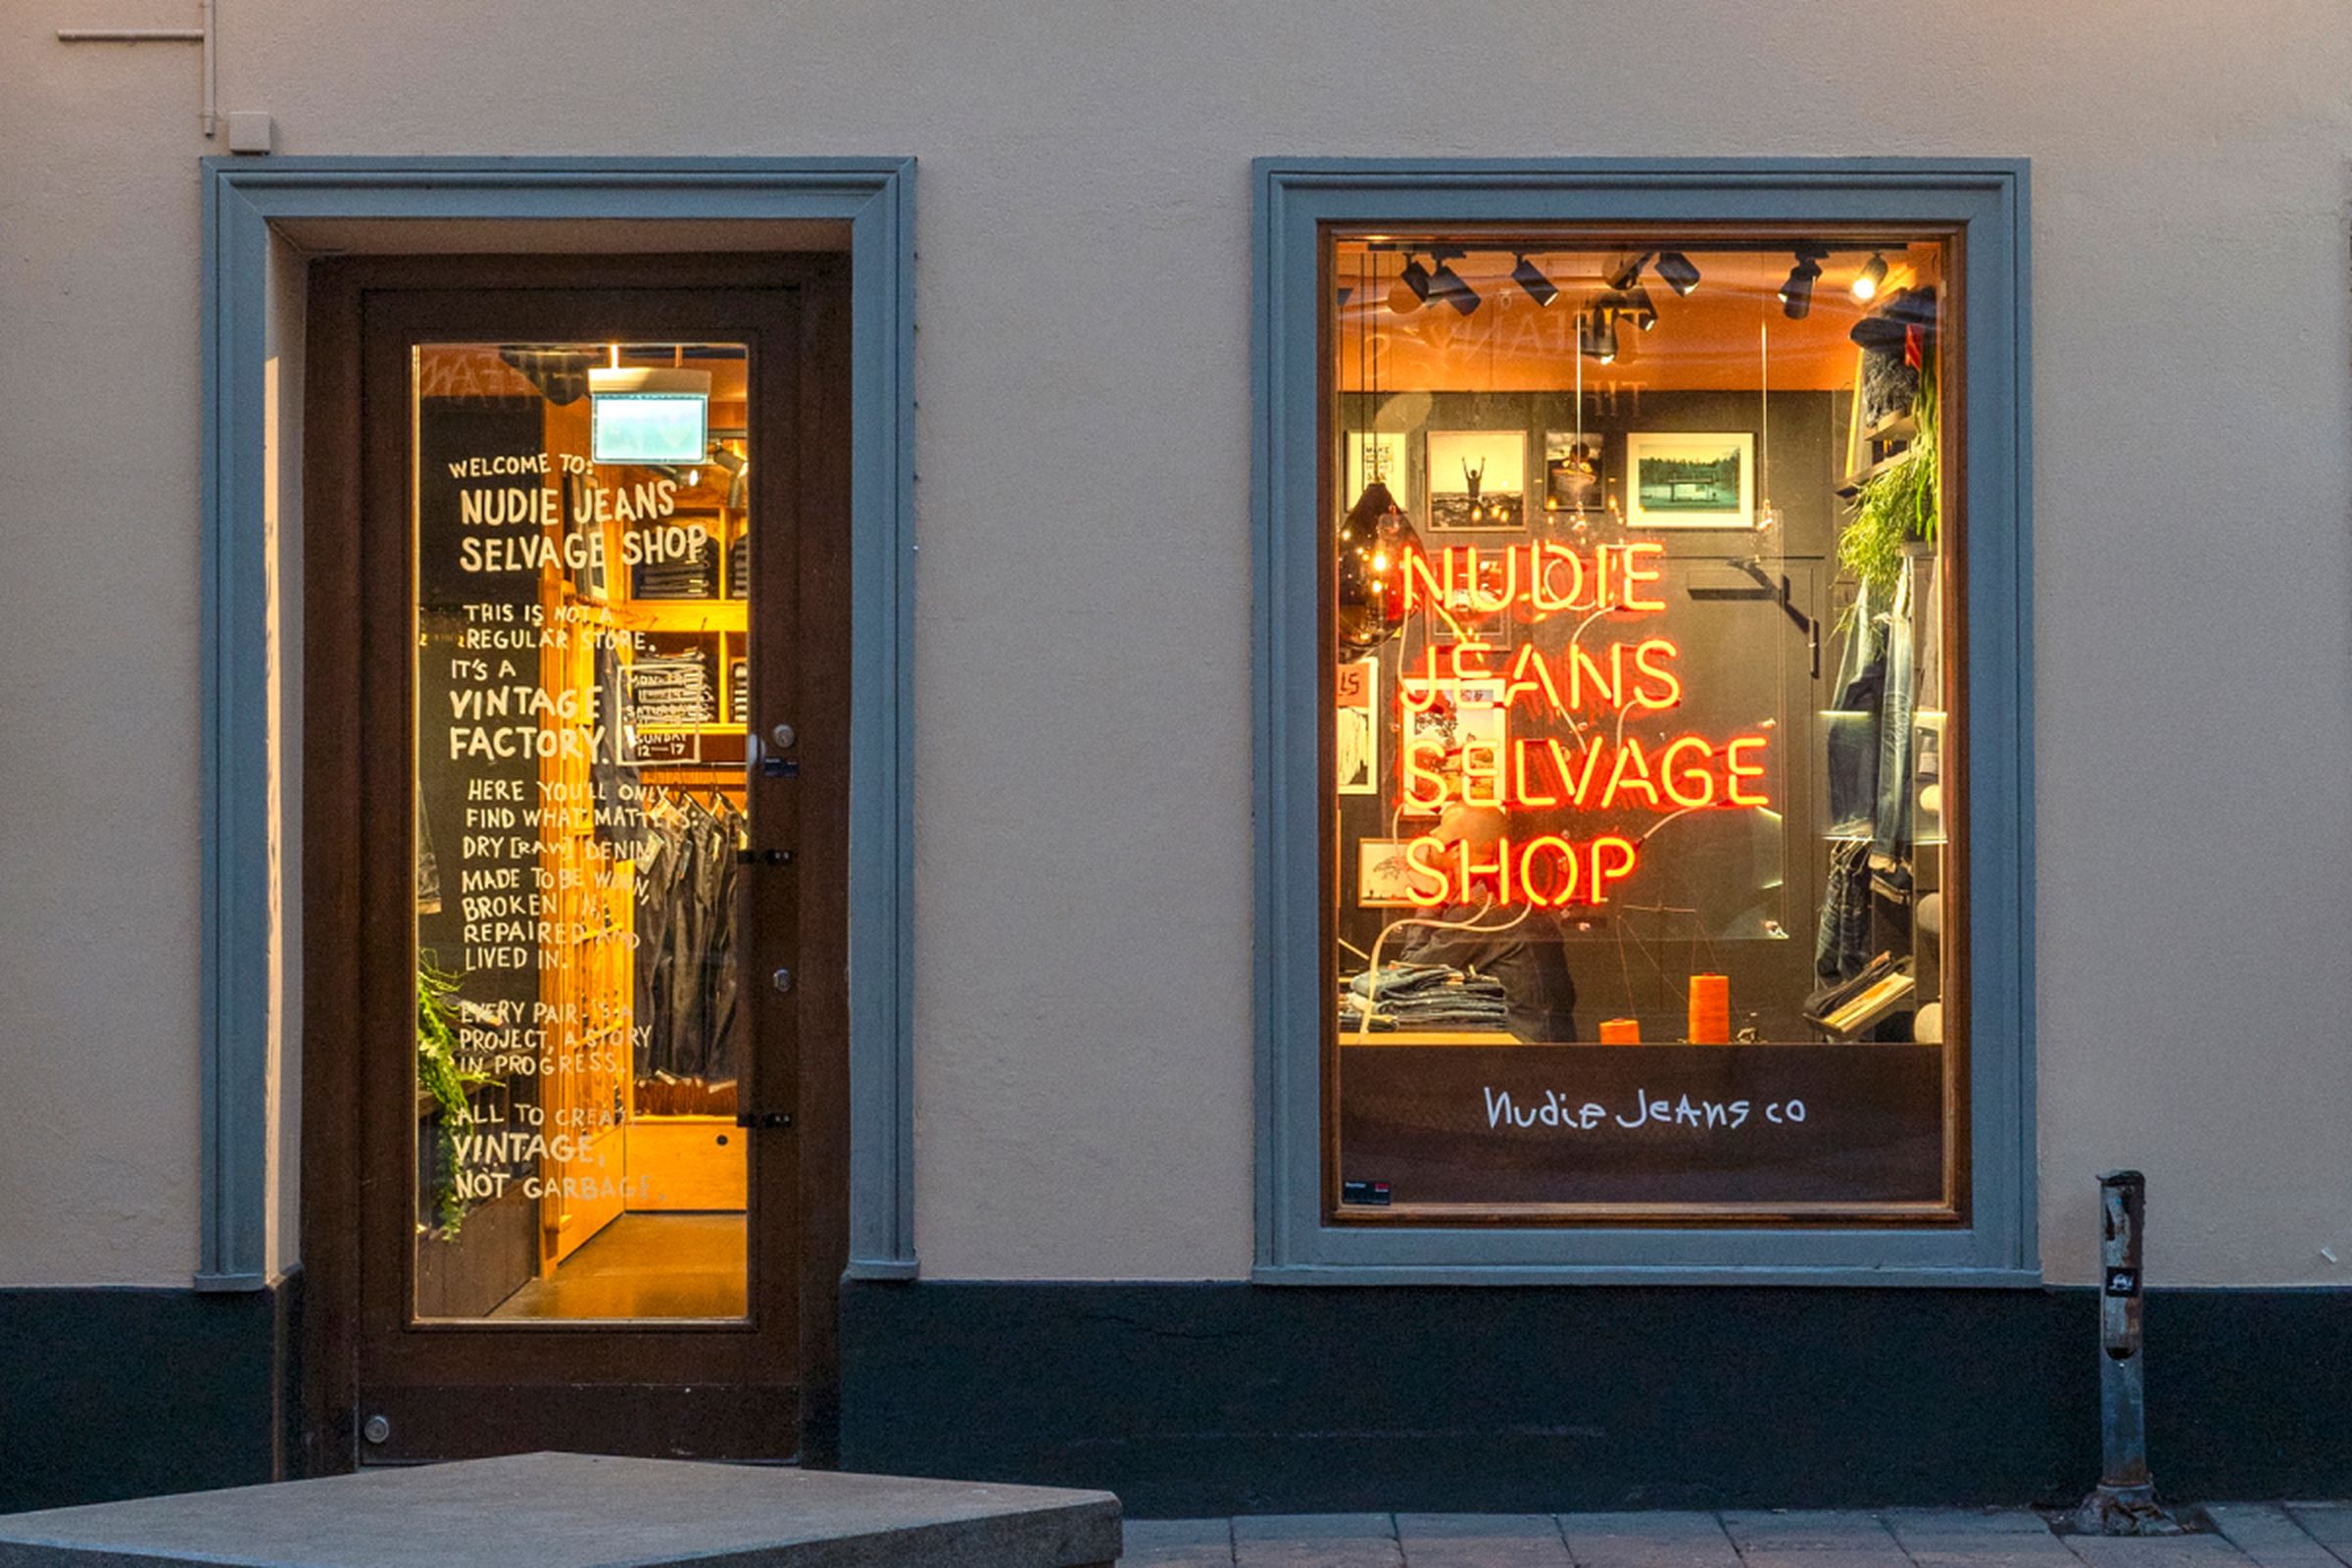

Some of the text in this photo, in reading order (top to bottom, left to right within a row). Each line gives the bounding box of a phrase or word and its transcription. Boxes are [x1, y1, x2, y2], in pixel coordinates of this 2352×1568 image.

[449, 454, 594, 478] WELCOME TO:
[461, 479, 677, 525] NUDIE JEANS
[460, 524, 708, 572] SELVAGE SHOP
[1401, 542, 1665, 612] NUDIE
[463, 604, 612, 625] THIS IS NOT A
[466, 628, 657, 653] REGULAR STORE.
[452, 659, 516, 681] IT'S A
[1398, 640, 1684, 712] JEANS
[450, 686, 604, 721] VINTAGE
[450, 725, 610, 765] FACTORY.
[1403, 736, 1770, 809] SELVAGE
[467, 779, 669, 804] HERE YOU'LL ONLY
[466, 808, 515, 828] FIND
[522, 808, 588, 829] WHAT
[463, 836, 505, 859] DRY
[463, 868, 519, 894] MADE
[531, 867, 553, 888] TO
[559, 868, 584, 890] BE
[1404, 836, 1638, 906] SHOP
[463, 894, 557, 921] BROKEN
[464, 922, 585, 946] REPAIRED
[466, 947, 569, 972] LIVED IN.
[461, 1000, 523, 1025] EVERY
[533, 1003, 579, 1025] PAIR
[460, 1025, 652, 1054] PROJECT, A STORY
[460, 1054, 626, 1076] IN PROGRESS.
[458, 1105, 505, 1125] ALL
[514, 1103, 545, 1126] TO
[453, 1131, 606, 1168] VINTAGE,
[455, 1168, 667, 1201] NOT GARBAGE.
